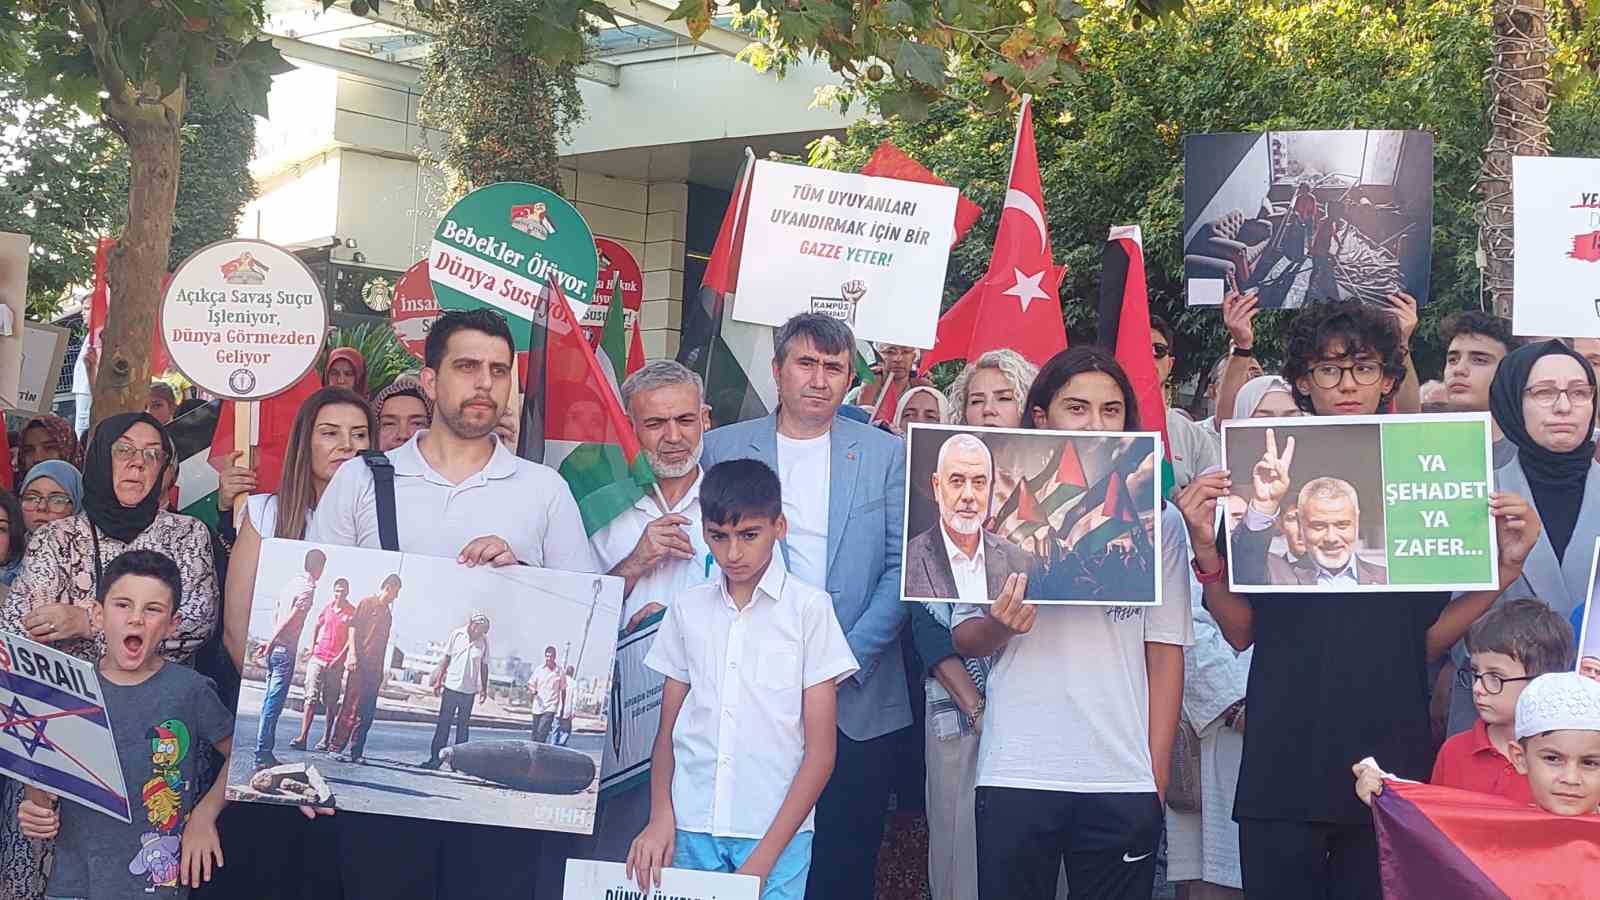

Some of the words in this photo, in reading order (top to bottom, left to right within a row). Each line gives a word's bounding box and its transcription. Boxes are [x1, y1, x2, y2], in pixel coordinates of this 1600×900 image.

[792, 184, 824, 203] TÜM
[828, 190, 917, 217] UYUYANLARI
[770, 208, 868, 237] UYANDIRMAK
[869, 220, 901, 243] İÇİN
[904, 227, 930, 246] BİR
[442, 219, 525, 268] Bebekler
[800, 240, 843, 260] GAZZE
[846, 247, 893, 267] YETER!
[435, 251, 496, 291] Dünya
[176, 288, 226, 306] Açıkça
[231, 289, 272, 308] Savaş
[276, 290, 313, 308] Suçu
[207, 307, 281, 327] İşleniyor,
[172, 328, 221, 346] Dünya
[226, 329, 316, 345] Görmezden
[216, 349, 271, 367] Geliyor
[1417, 454, 1447, 472] YA
[1386, 482, 1486, 505] ŞEHADET
[1419, 510, 1449, 528] YA
[1394, 538, 1483, 557] ZAFER...
[6, 636, 97, 700] İSRAİL
